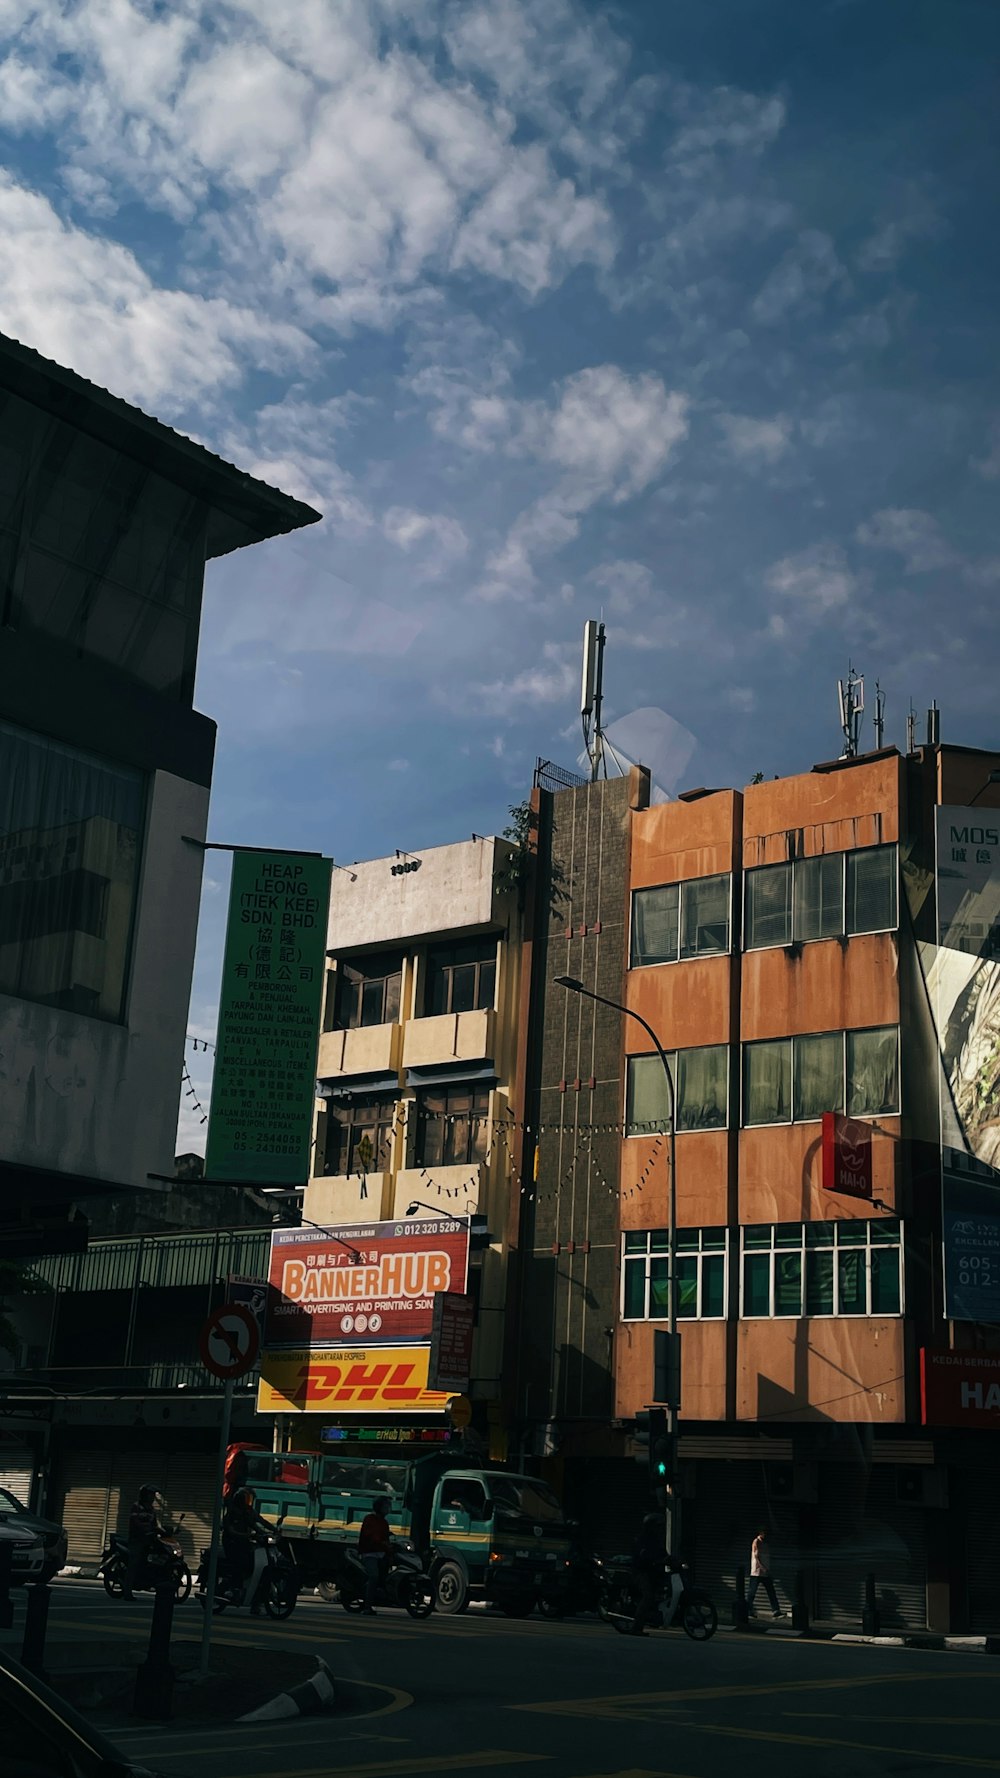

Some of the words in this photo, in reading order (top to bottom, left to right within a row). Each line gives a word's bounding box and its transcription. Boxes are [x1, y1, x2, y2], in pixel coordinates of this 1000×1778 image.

[261, 863, 304, 879] HEAP
[255, 878, 308, 896] LEONG
[240, 893, 279, 910] (TIEK
[284, 897, 320, 913] KEE)
[240, 909, 277, 926] SDN.
[282, 912, 317, 929] BHD.
[234, 961, 314, 982] 有限公司
[248, 981, 297, 993] PEMBORONG
[260, 992, 294, 1003] PENJUAL
[224, 1010, 255, 1021] PAYUNG
[257, 1012, 274, 1022] DAN
[840, 1169, 866, 1190] HAI-O
[404, 1224, 420, 1236] 012
[422, 1222, 438, 1234] 320
[439, 1221, 461, 1233] 5289
[273, 1304, 300, 1316] SMART
[303, 1302, 354, 1315] ADVERTISING
[356, 1301, 373, 1312] AND
[374, 1300, 413, 1311] PRINTING
[344, 1351, 366, 1360] EKSPRES
[932, 1355, 962, 1365] KEDAI
[294, 1364, 422, 1400] DHL
